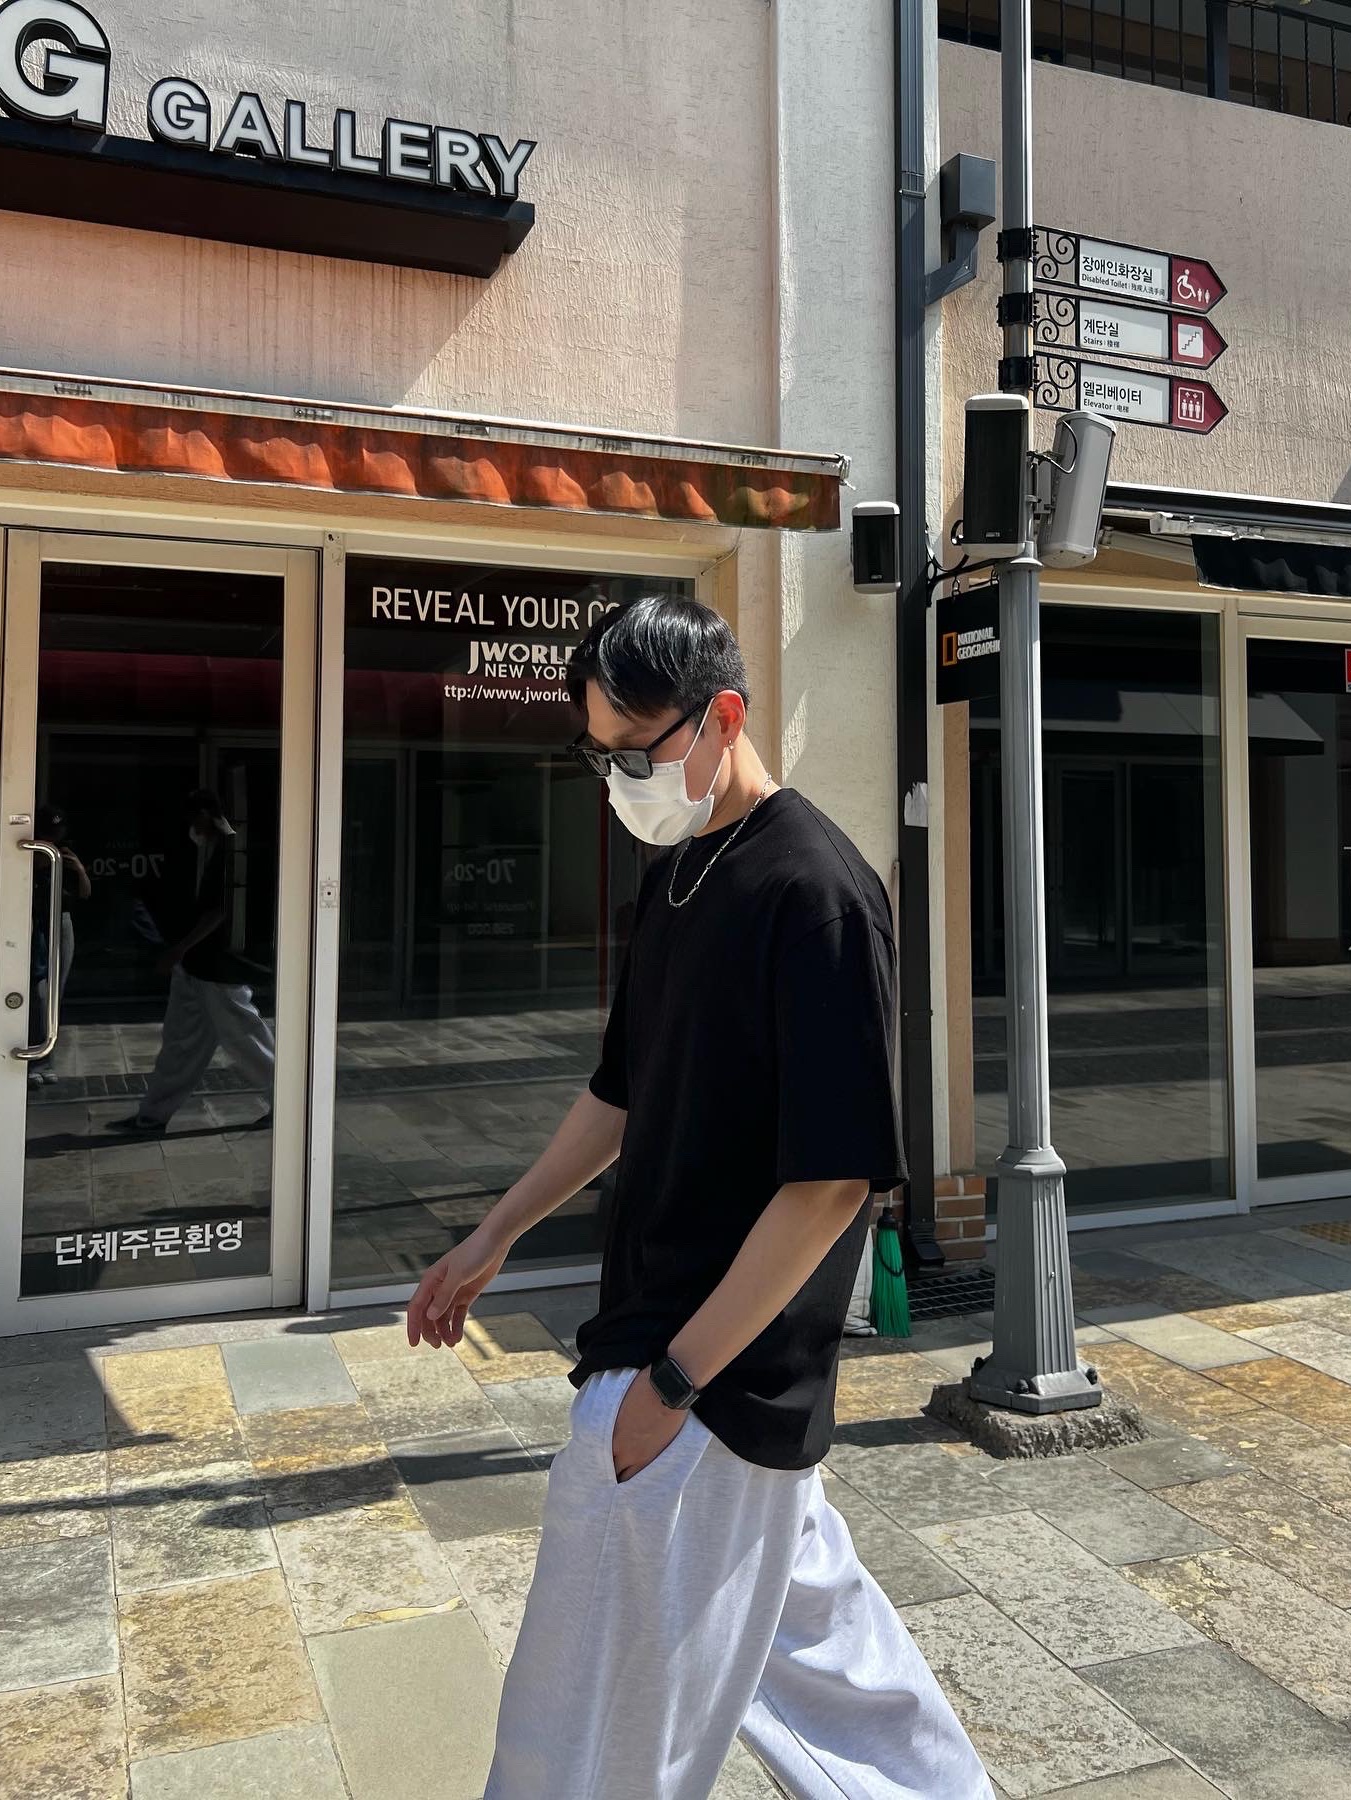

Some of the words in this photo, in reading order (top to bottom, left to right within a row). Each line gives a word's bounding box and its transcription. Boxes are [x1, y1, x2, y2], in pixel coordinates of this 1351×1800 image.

[148, 77, 538, 200] GALLERY
[1082, 256, 1153, 283] 장애인화장실
[1081, 273, 1109, 286] Disabled
[1111, 279, 1128, 289] Toilet
[1084, 319, 1119, 337] 계단실
[1083, 336, 1103, 346] Stairs
[1083, 381, 1142, 405] 엘리베이터
[1083, 398, 1112, 411] Elevator
[372, 586, 495, 626] REVEAL
[501, 595, 580, 631] YOUR
[957, 626, 996, 647] NATIONAL
[484, 662, 525, 679] NEW
[55, 1219, 244, 1266] 단체주문환영
